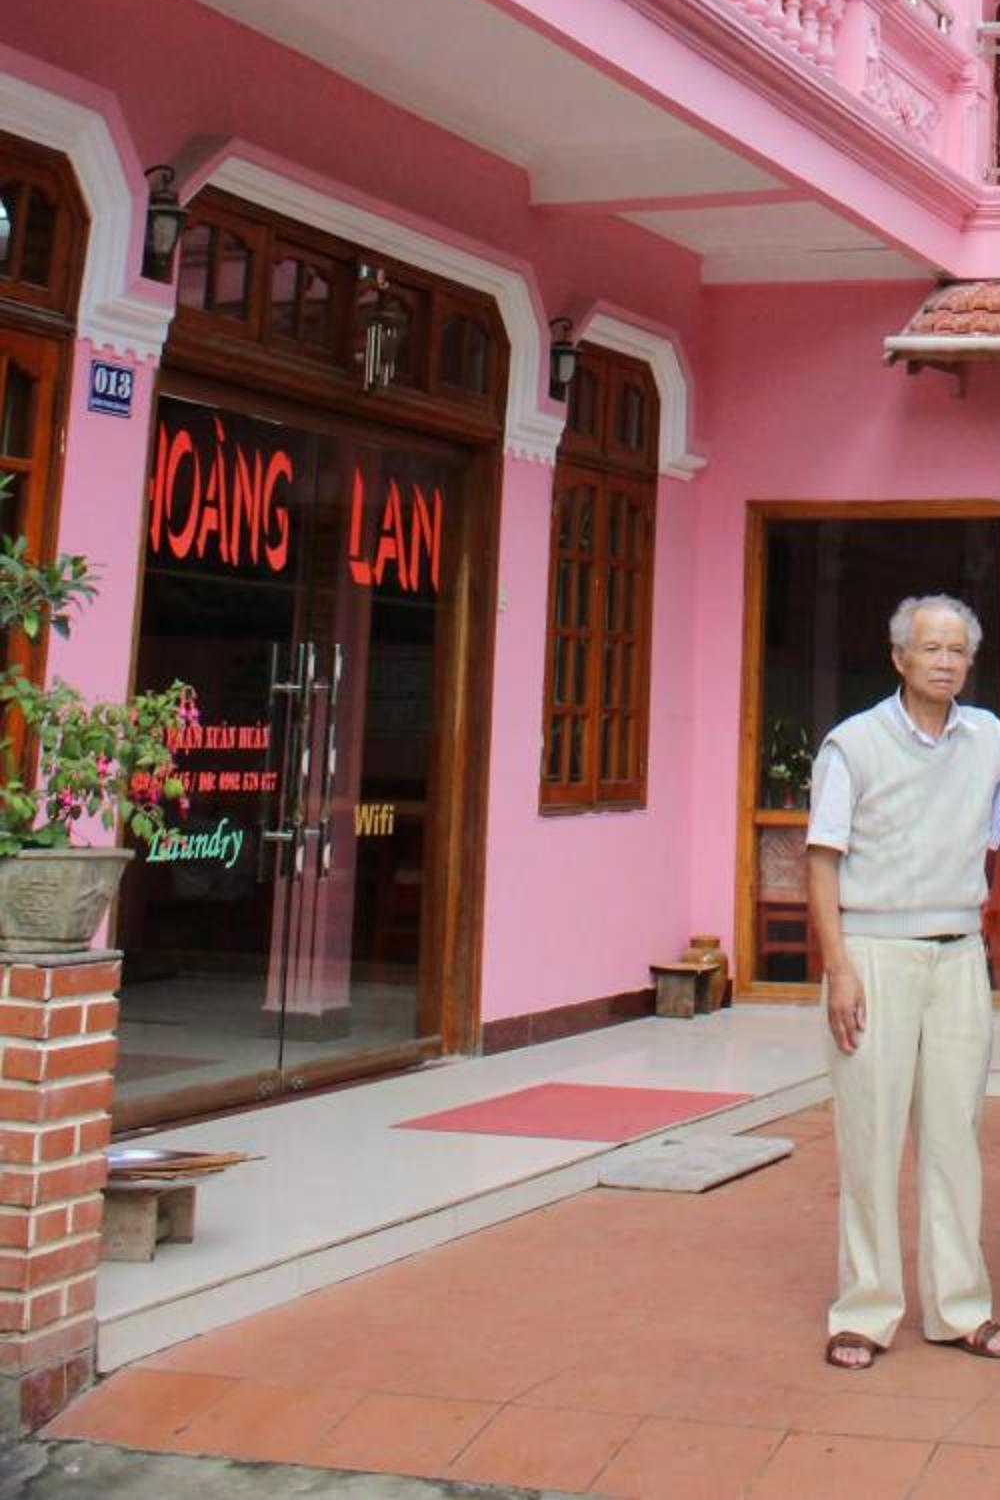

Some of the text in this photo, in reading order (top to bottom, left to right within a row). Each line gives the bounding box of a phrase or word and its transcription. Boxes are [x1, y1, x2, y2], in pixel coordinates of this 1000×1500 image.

[95, 367, 131, 399] 013
[349, 465, 443, 593] LAN
[354, 804, 395, 836] Wifi
